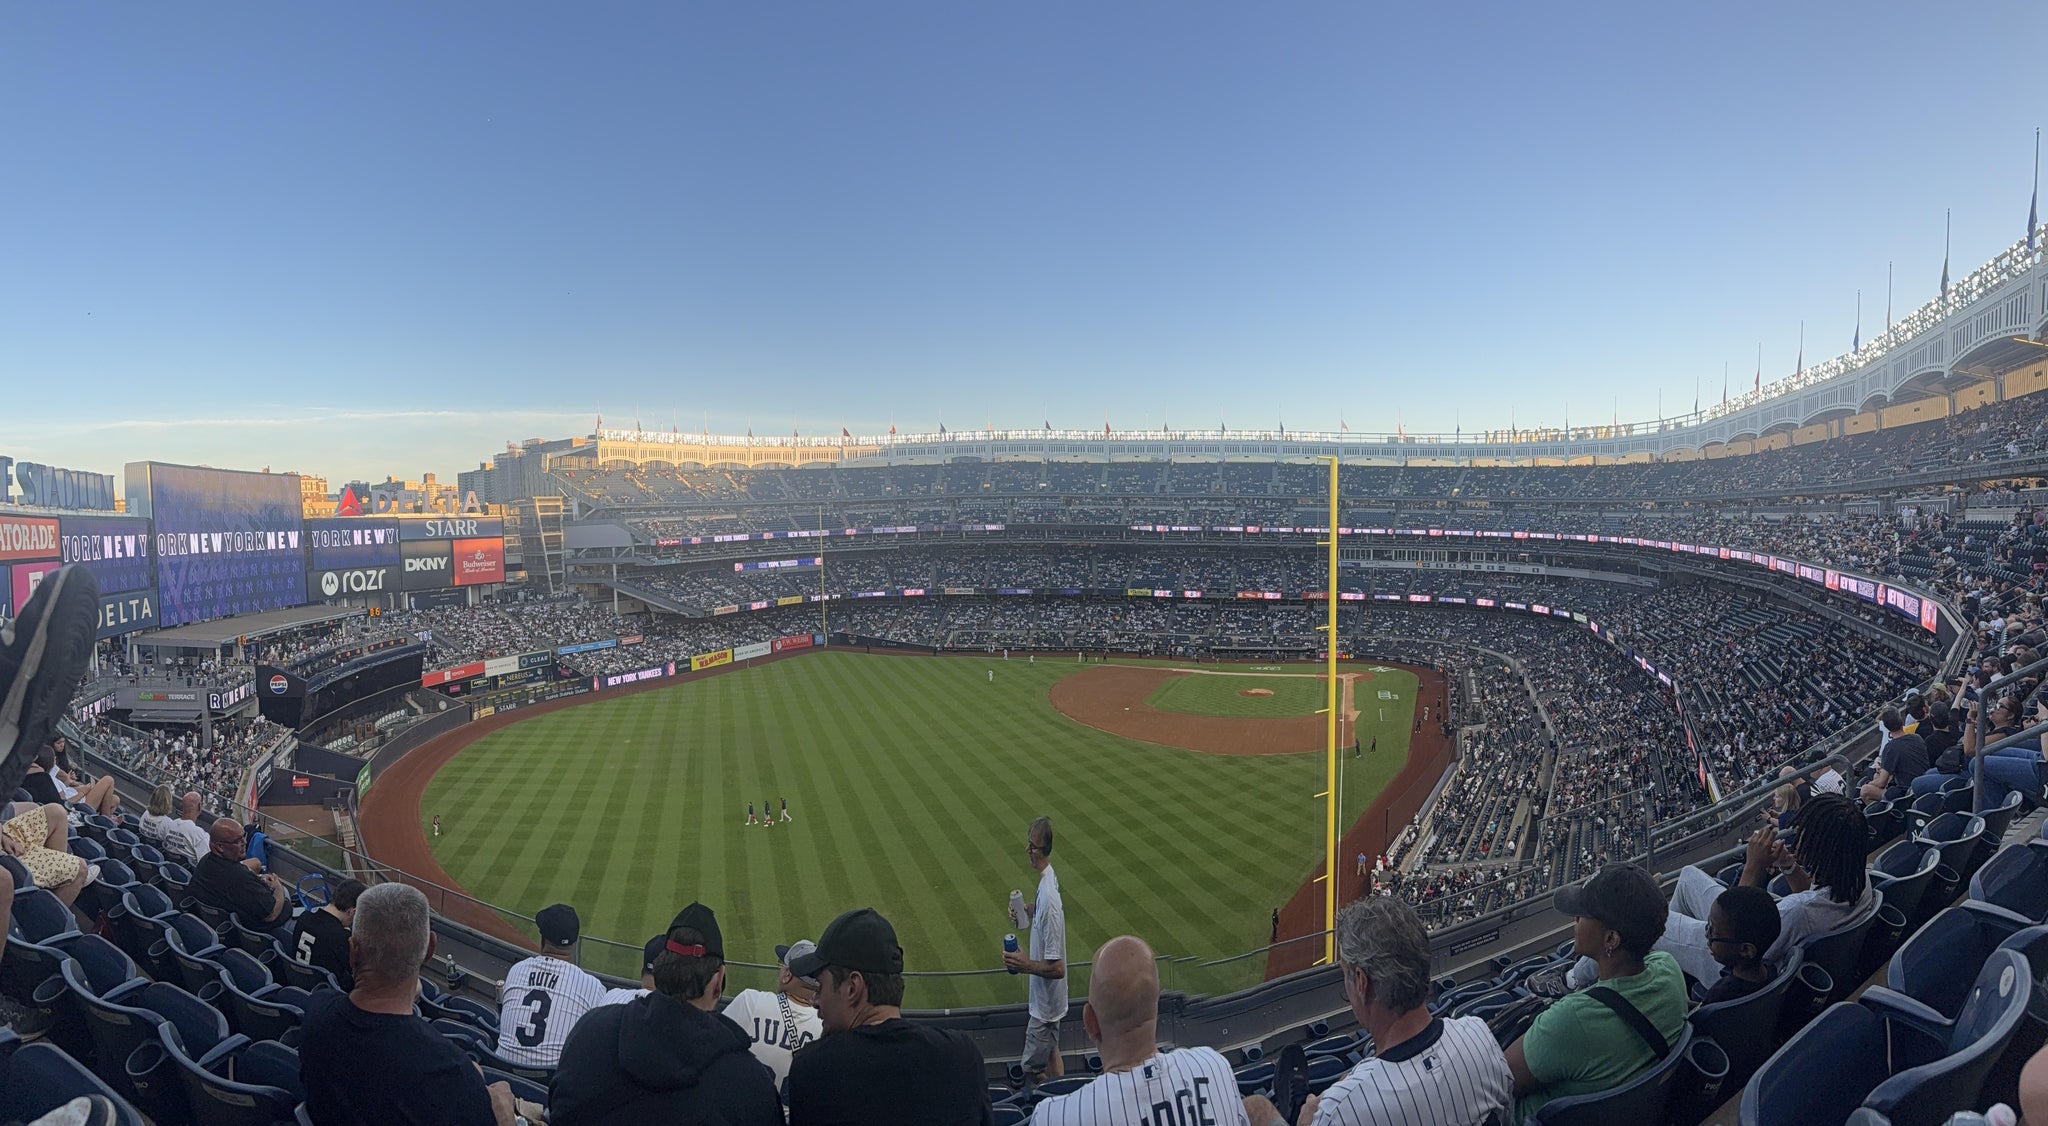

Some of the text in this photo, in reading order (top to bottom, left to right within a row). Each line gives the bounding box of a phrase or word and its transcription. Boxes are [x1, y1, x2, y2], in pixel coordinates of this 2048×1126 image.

[16, 461, 115, 511] STADIUM
[372, 489, 482, 514] DELTA
[426, 520, 477, 537] STARR
[405, 556, 448, 572] DKNY
[463, 560, 497, 569] Budweiser
[342, 569, 386, 593] razr
[506, 672, 529, 681] NEREUS
[608, 668, 662, 686] NEW YORK YANKEES
[498, 702, 517, 713] STARR
[528, 971, 559, 990] RUTH
[515, 989, 552, 1047] 3
